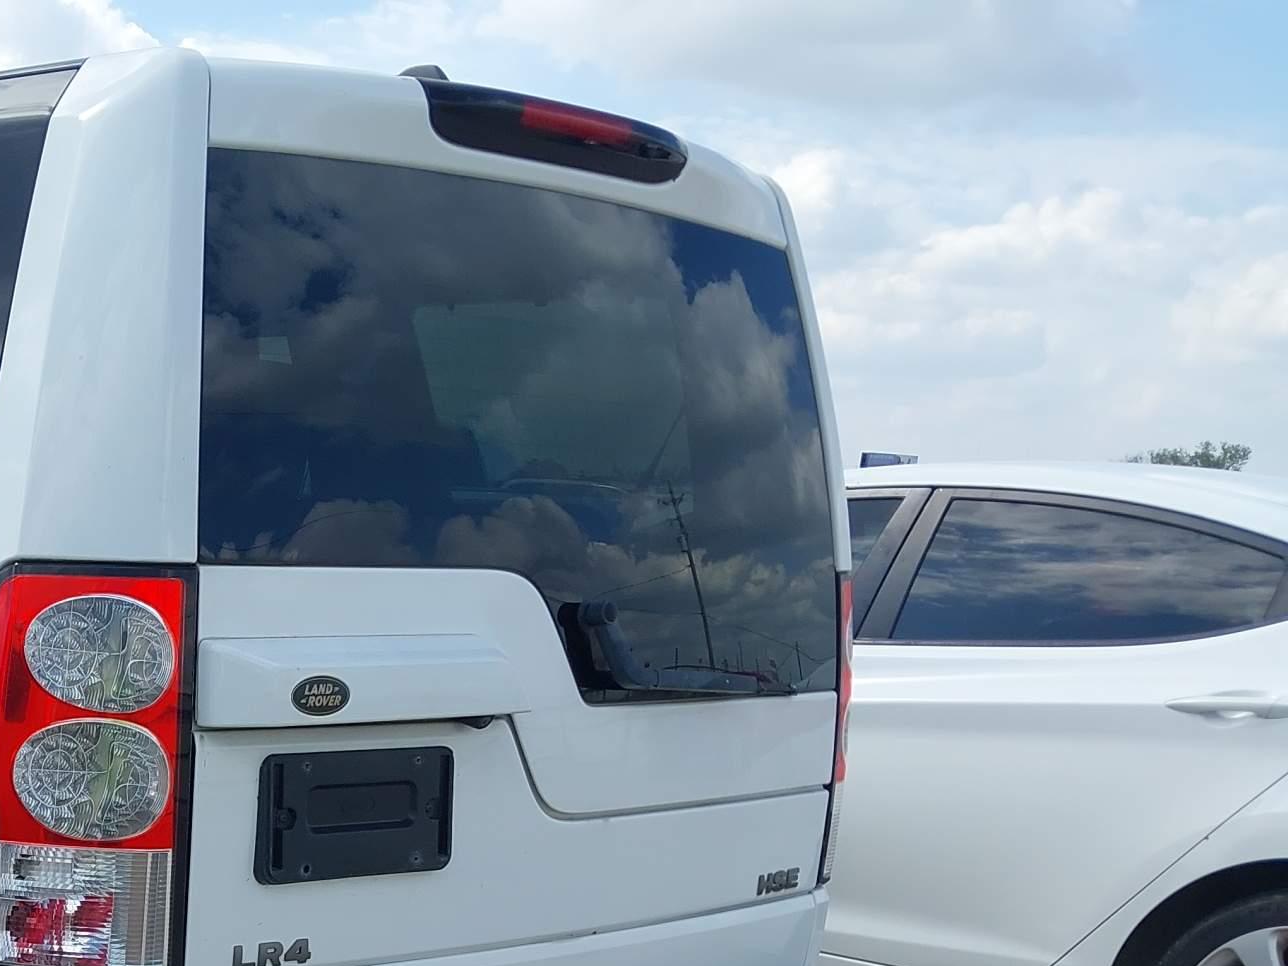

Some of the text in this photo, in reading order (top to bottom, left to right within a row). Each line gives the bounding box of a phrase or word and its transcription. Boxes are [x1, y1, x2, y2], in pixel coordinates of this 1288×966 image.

[304, 683, 333, 696] LAND
[306, 694, 342, 707] ROVER
[756, 867, 800, 896] HSE
